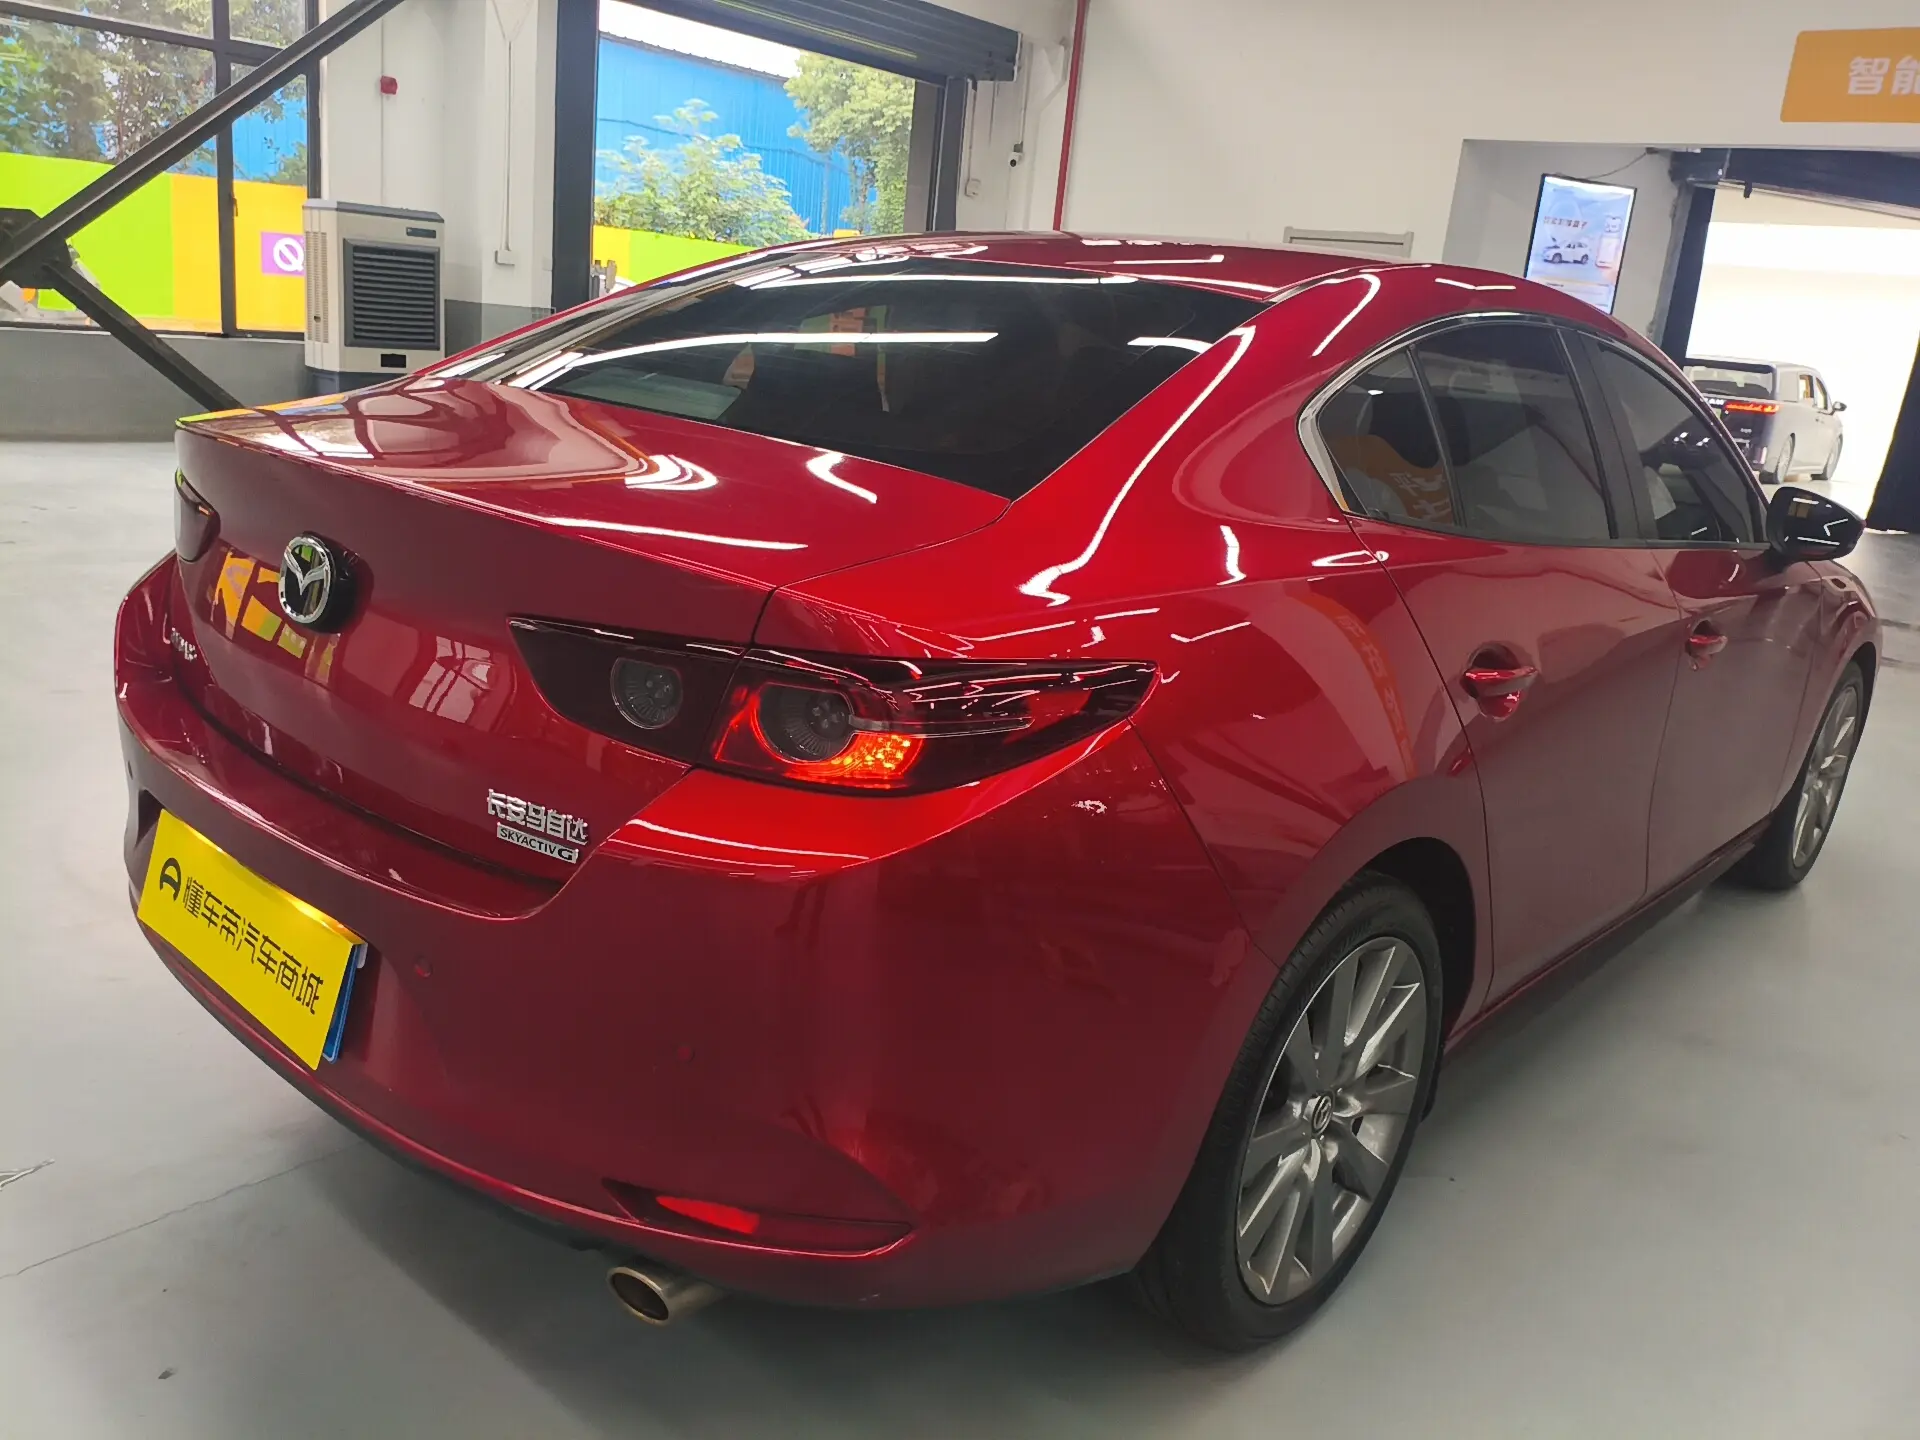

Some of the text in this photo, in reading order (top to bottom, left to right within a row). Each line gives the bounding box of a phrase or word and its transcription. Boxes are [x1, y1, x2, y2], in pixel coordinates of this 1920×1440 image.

[1848, 56, 1920, 95] 智能
[487, 788, 588, 846] 长安马自达
[183, 876, 324, 1015] 懂车帝汽车商城
